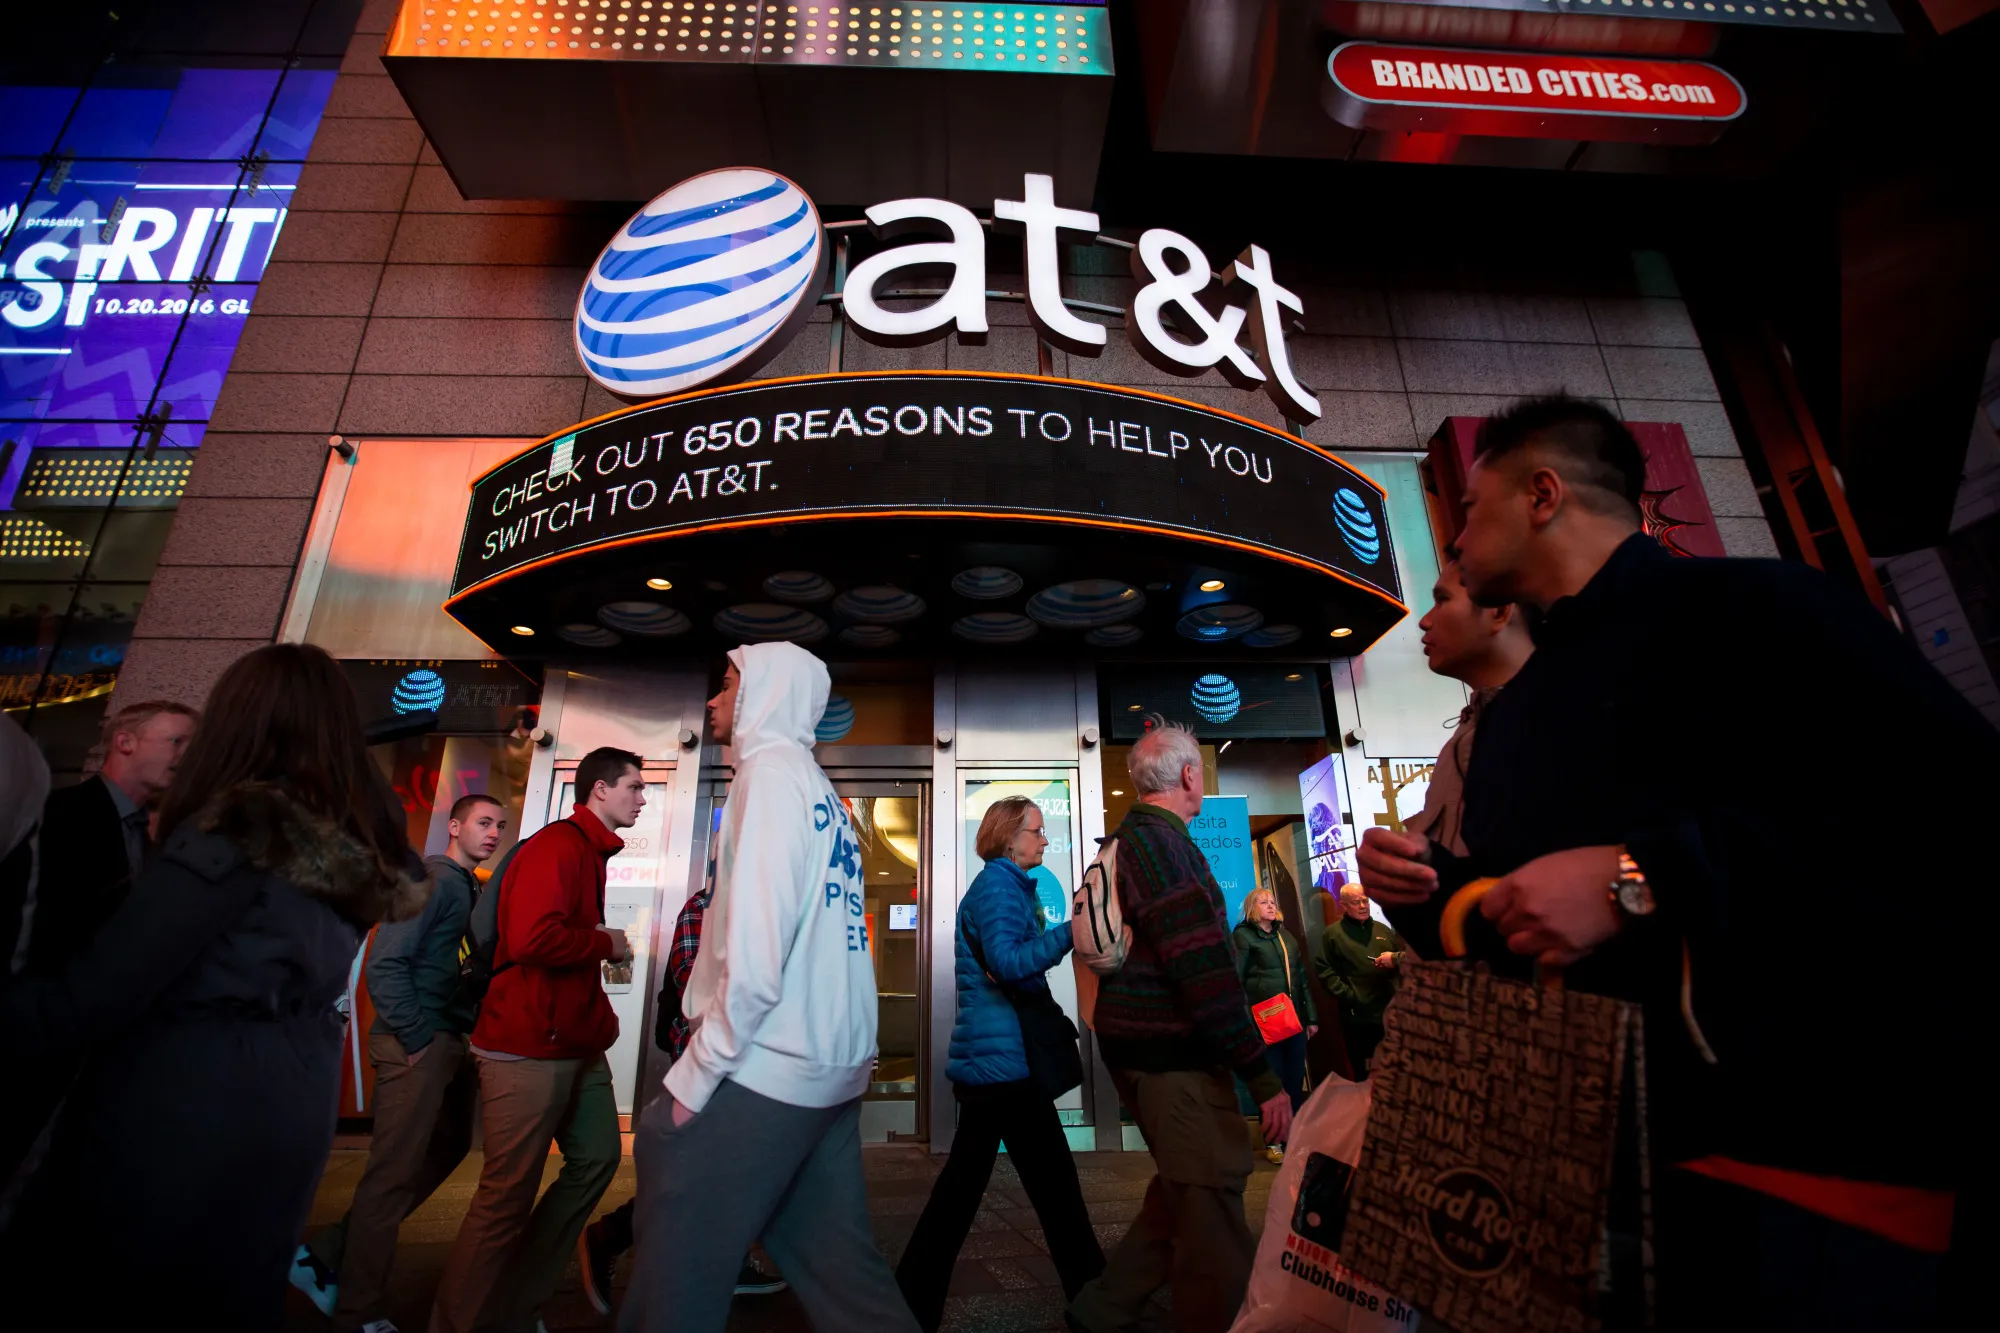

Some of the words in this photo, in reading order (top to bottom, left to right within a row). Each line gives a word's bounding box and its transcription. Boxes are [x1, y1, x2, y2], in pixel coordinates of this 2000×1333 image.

[1371, 59, 1532, 94] BRANDED
[1537, 67, 1715, 105] CITIES.com
[25, 216, 85, 229] presents
[98, 207, 288, 281] RIT
[95, 299, 214, 314] 10.20.2016
[843, 171, 1321, 418] at&t
[492, 454, 586, 517] CHECK
[596, 432, 674, 476] OUT
[682, 417, 761, 456] 650
[773, 405, 993, 443] REASONS
[1008, 409, 1071, 441] TO
[1089, 417, 1191, 459] HELP
[1200, 438, 1273, 483] YOU
[482, 493, 596, 560] SWITCH
[606, 479, 658, 515] TO
[667, 460, 779, 504] AT&T.
[1193, 835, 1242, 849] tados
[1394, 1165, 1474, 1222] Hard
[1471, 1197, 1545, 1265] Rock
[1281, 1251, 1379, 1312] Clubhouse
